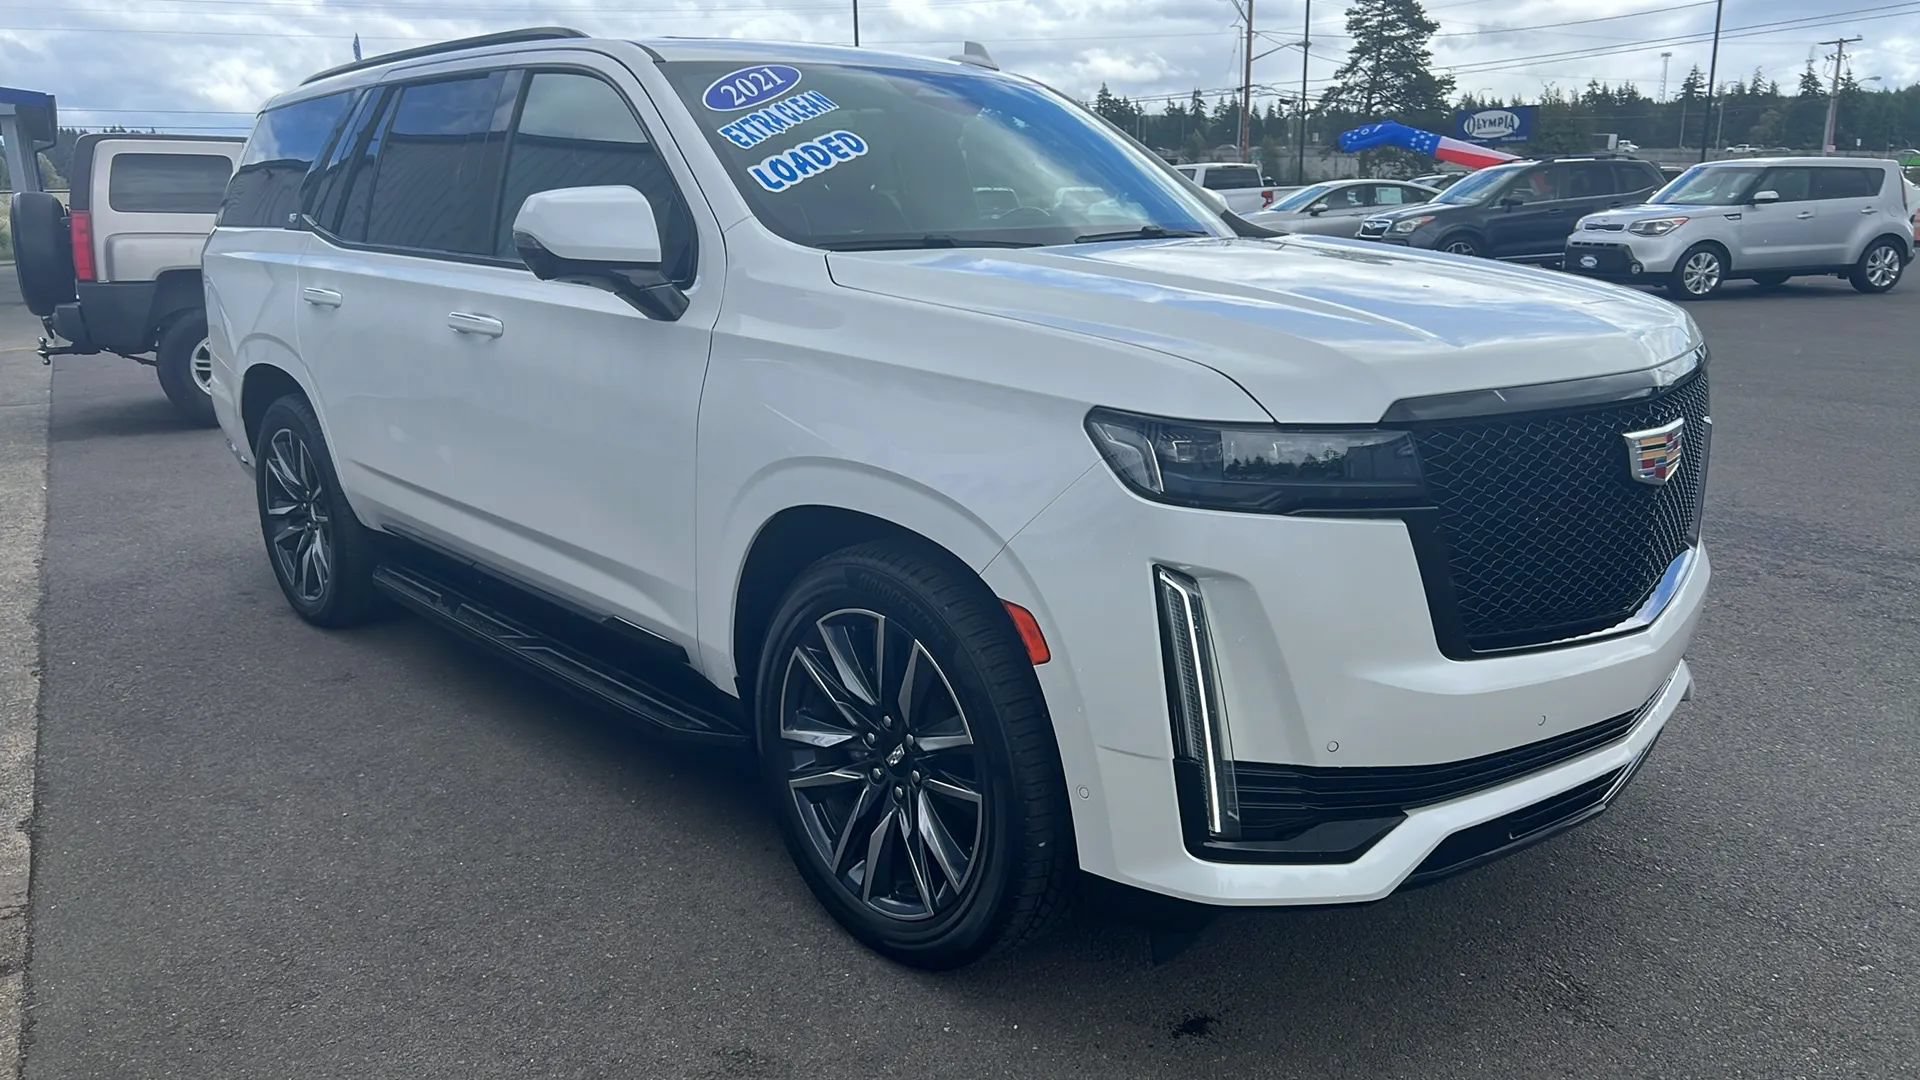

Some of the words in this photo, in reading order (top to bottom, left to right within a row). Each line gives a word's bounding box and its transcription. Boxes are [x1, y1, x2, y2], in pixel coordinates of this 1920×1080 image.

[720, 67, 786, 106] 2021
[1467, 113, 1516, 136] OLYMPIA
[752, 131, 865, 190] LOADED
